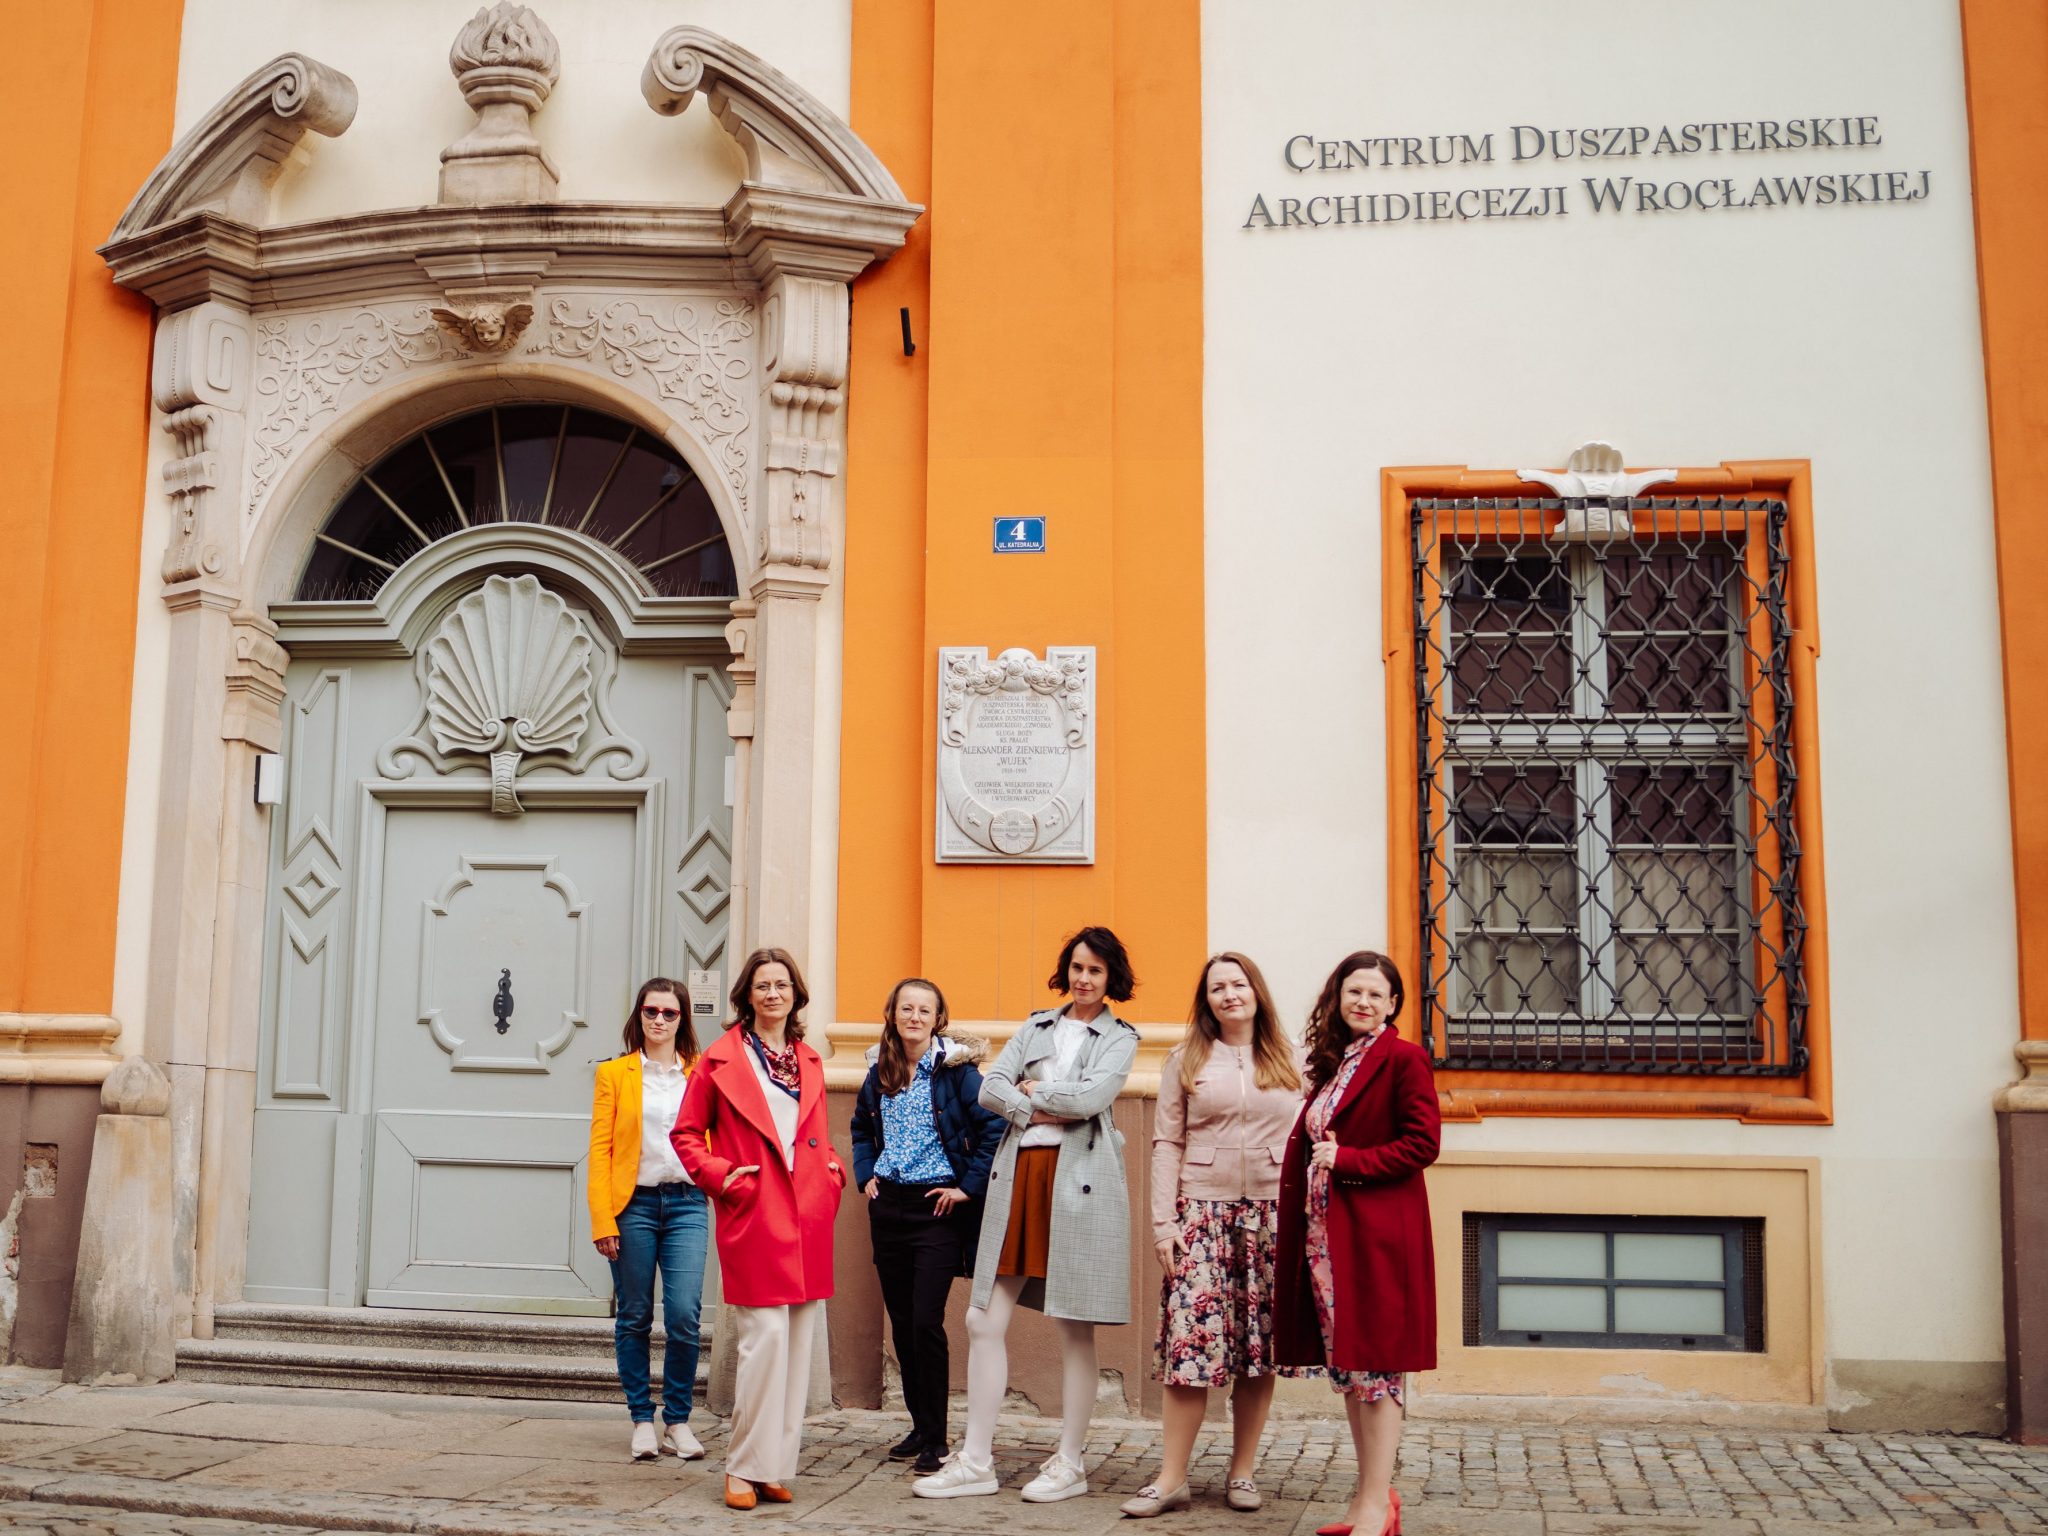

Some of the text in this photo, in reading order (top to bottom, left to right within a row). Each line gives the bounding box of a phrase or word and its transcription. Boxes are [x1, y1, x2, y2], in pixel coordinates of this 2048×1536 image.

[1283, 115, 1883, 174] CENTRUM DUSZPASTERSKIE
[1241, 169, 1931, 231] ARCHIDIECEZJI WROCŁAWSKIEJ
[1010, 520, 1026, 541] 4
[962, 745, 1068, 755] ALEKSANDER ZIENKIEWICZ
